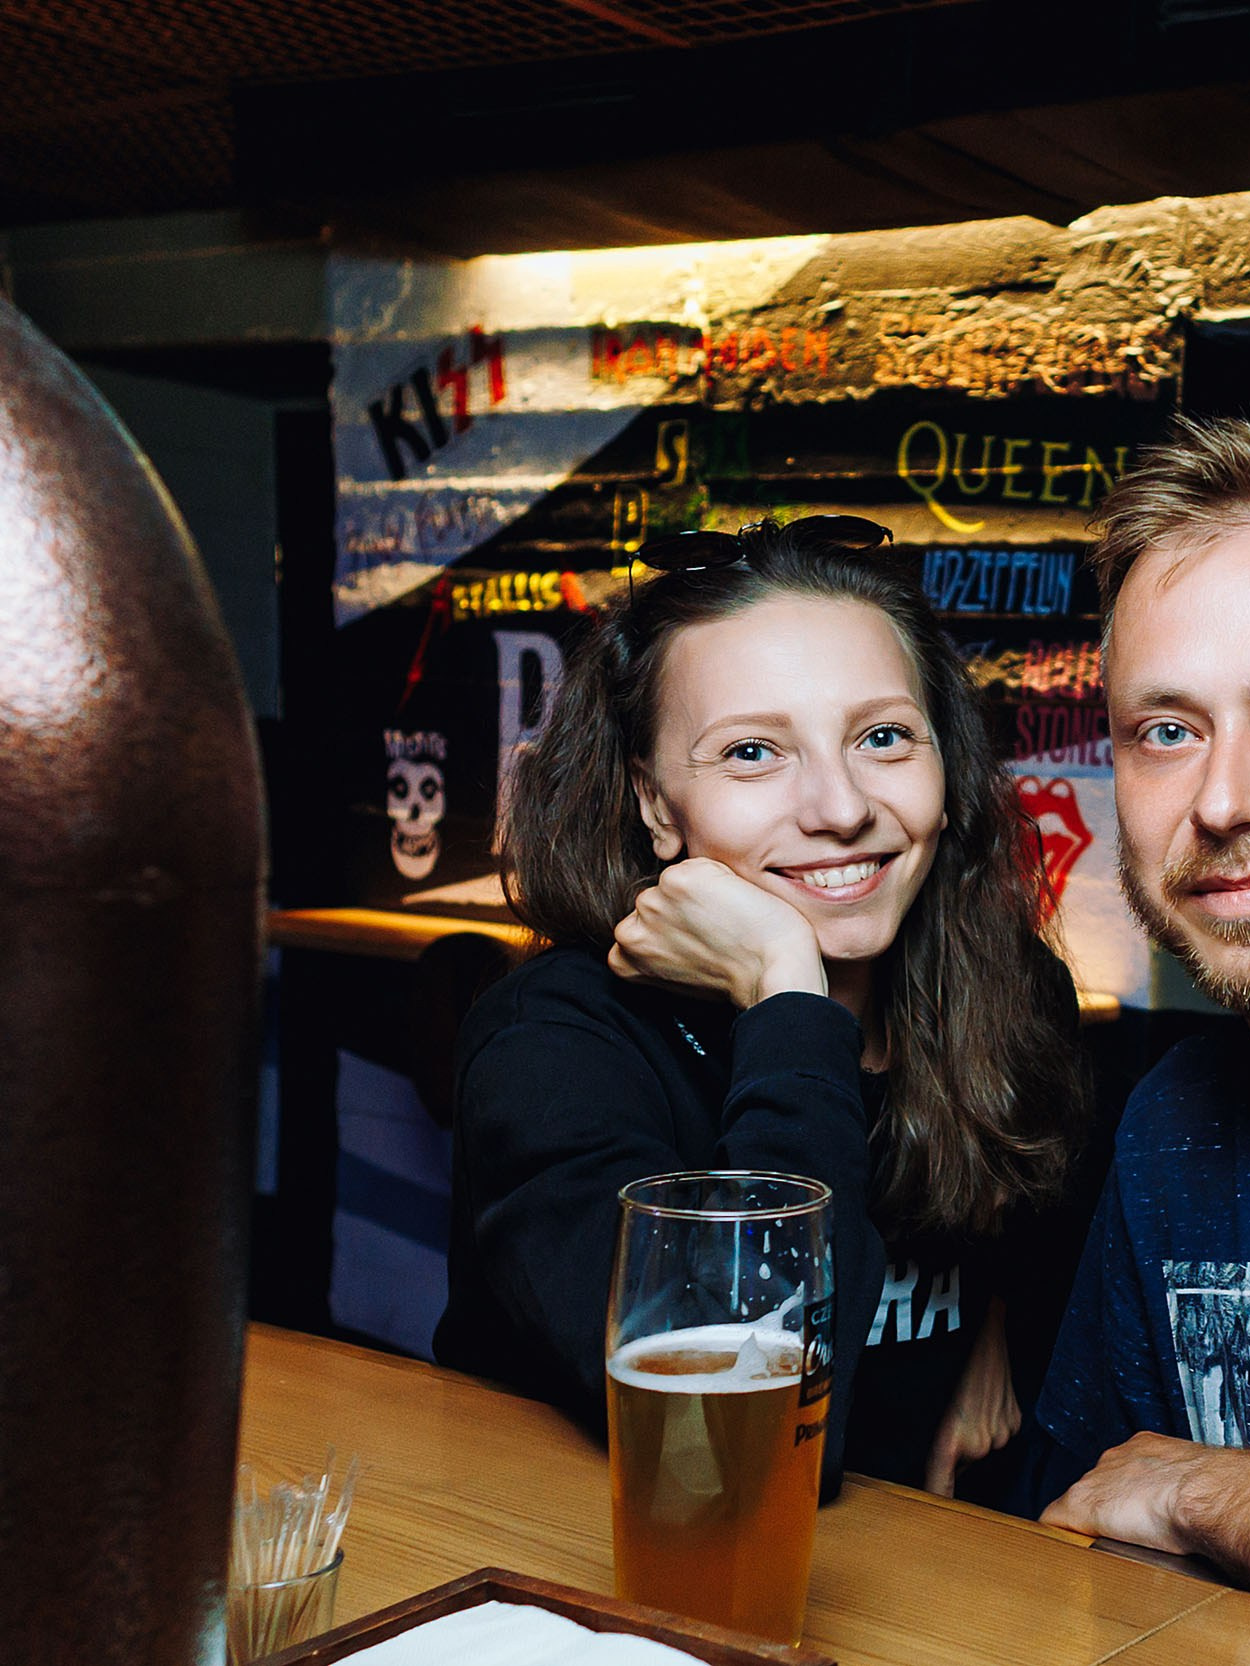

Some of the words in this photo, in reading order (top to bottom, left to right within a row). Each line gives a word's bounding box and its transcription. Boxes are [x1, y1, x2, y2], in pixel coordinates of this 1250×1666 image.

[369, 325, 505, 479] KISS
[897, 419, 1130, 532] QUEEN
[865, 1259, 961, 1347] RA
